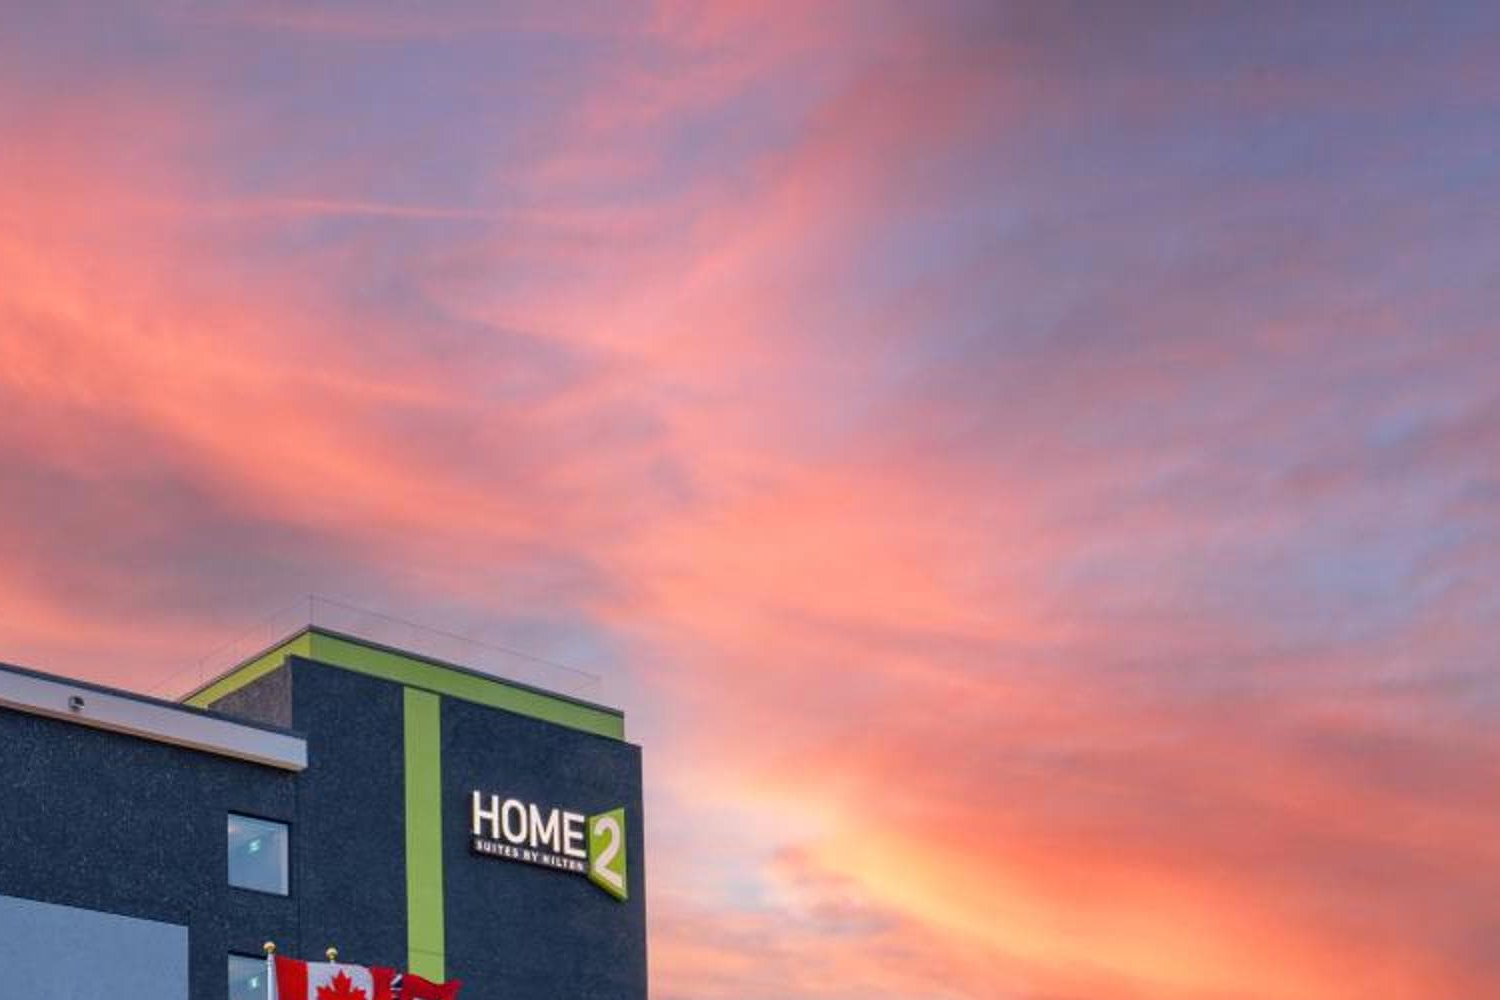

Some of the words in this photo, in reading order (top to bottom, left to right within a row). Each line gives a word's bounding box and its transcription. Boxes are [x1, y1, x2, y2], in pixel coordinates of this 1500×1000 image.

[472, 789, 587, 859] HOME
[593, 816, 624, 889] 2
[476, 840, 519, 859] SUITES
[523, 849, 539, 863] BY
